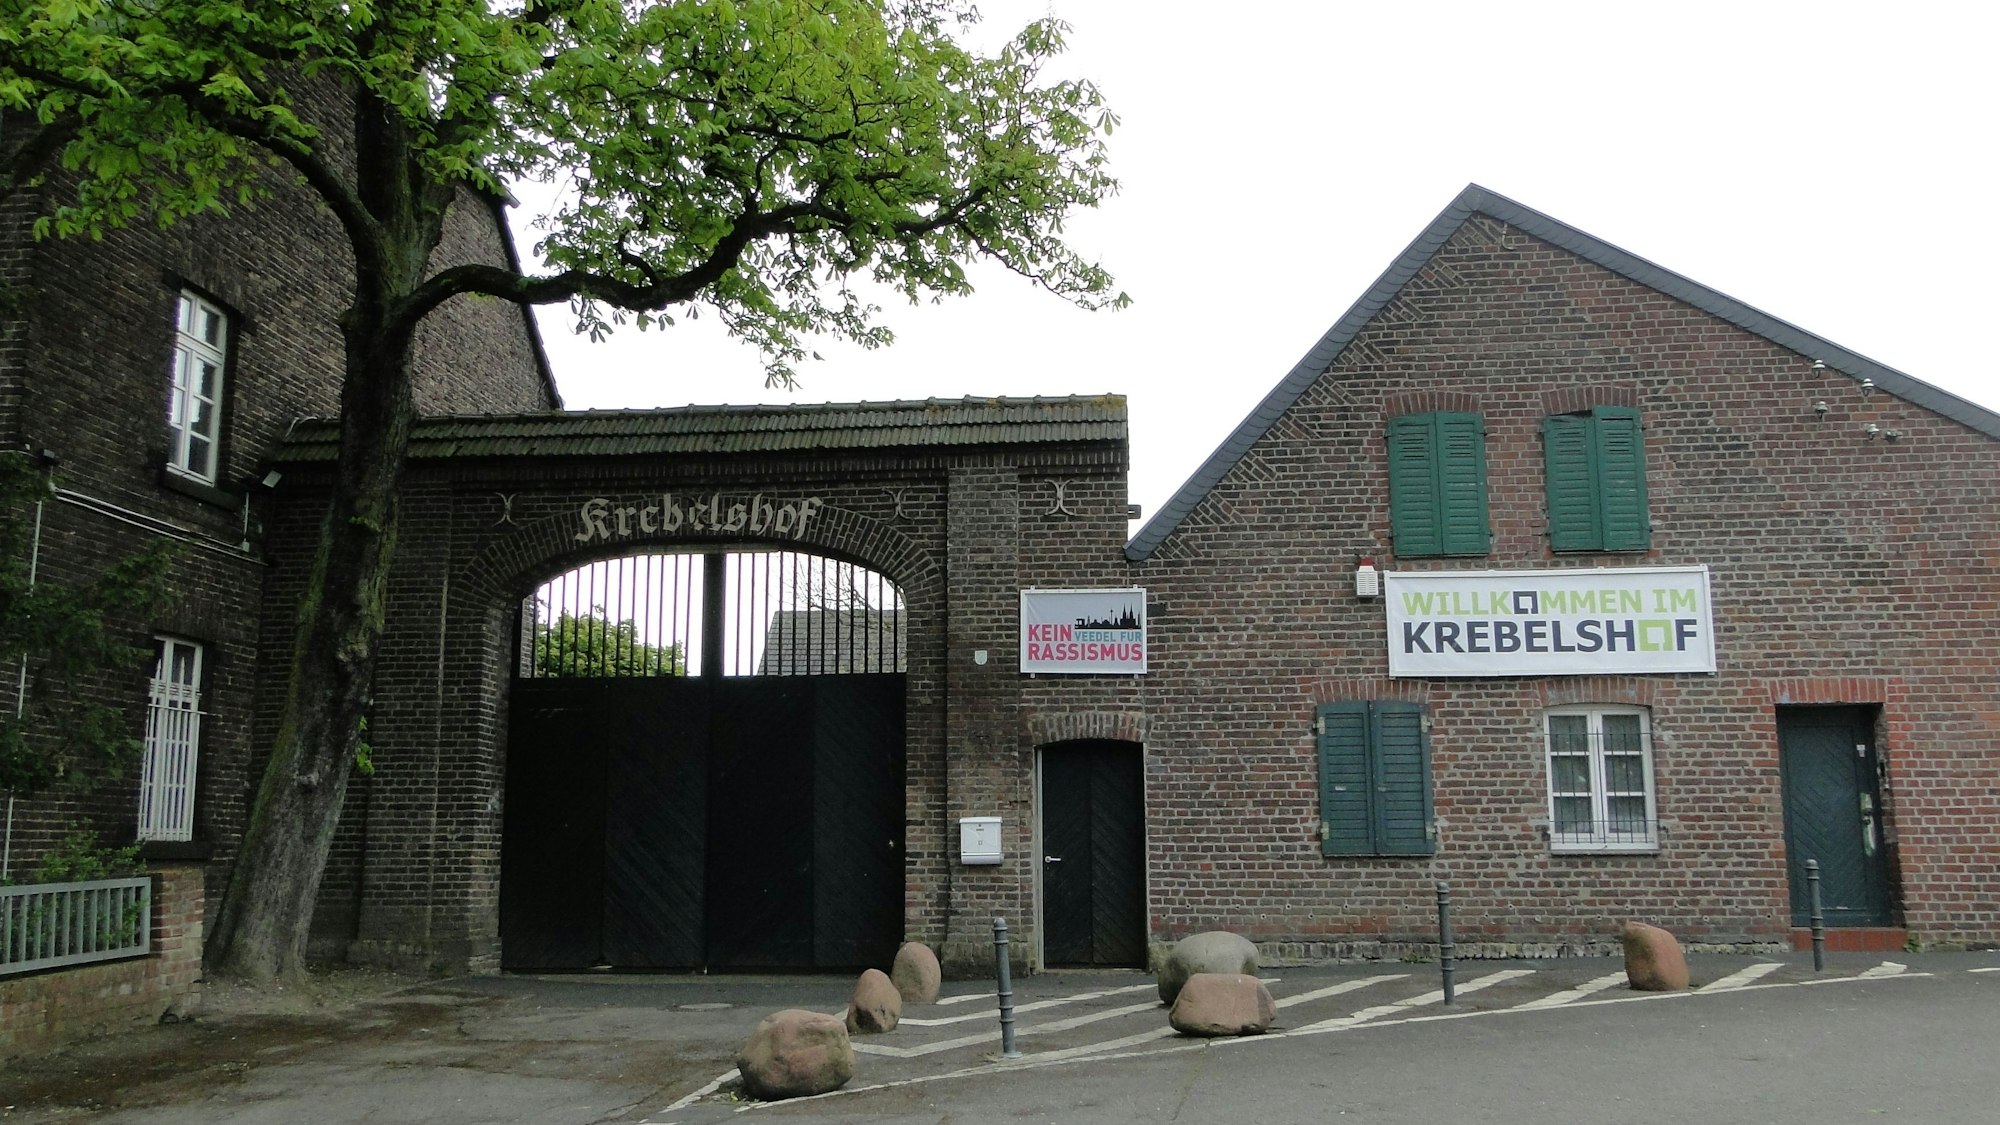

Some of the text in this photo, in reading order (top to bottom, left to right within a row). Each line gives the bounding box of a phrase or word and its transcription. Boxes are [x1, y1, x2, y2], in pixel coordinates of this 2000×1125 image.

[575, 492, 823, 541] Krebelshof
[1402, 588, 1697, 616] WILLKOMMEN IM
[1028, 624, 1072, 642] KEIN
[1075, 631, 1116, 642] VEEDEL
[1402, 618, 1698, 654] KREBELSHOF
[1028, 643, 1143, 661] RASSISMUS
